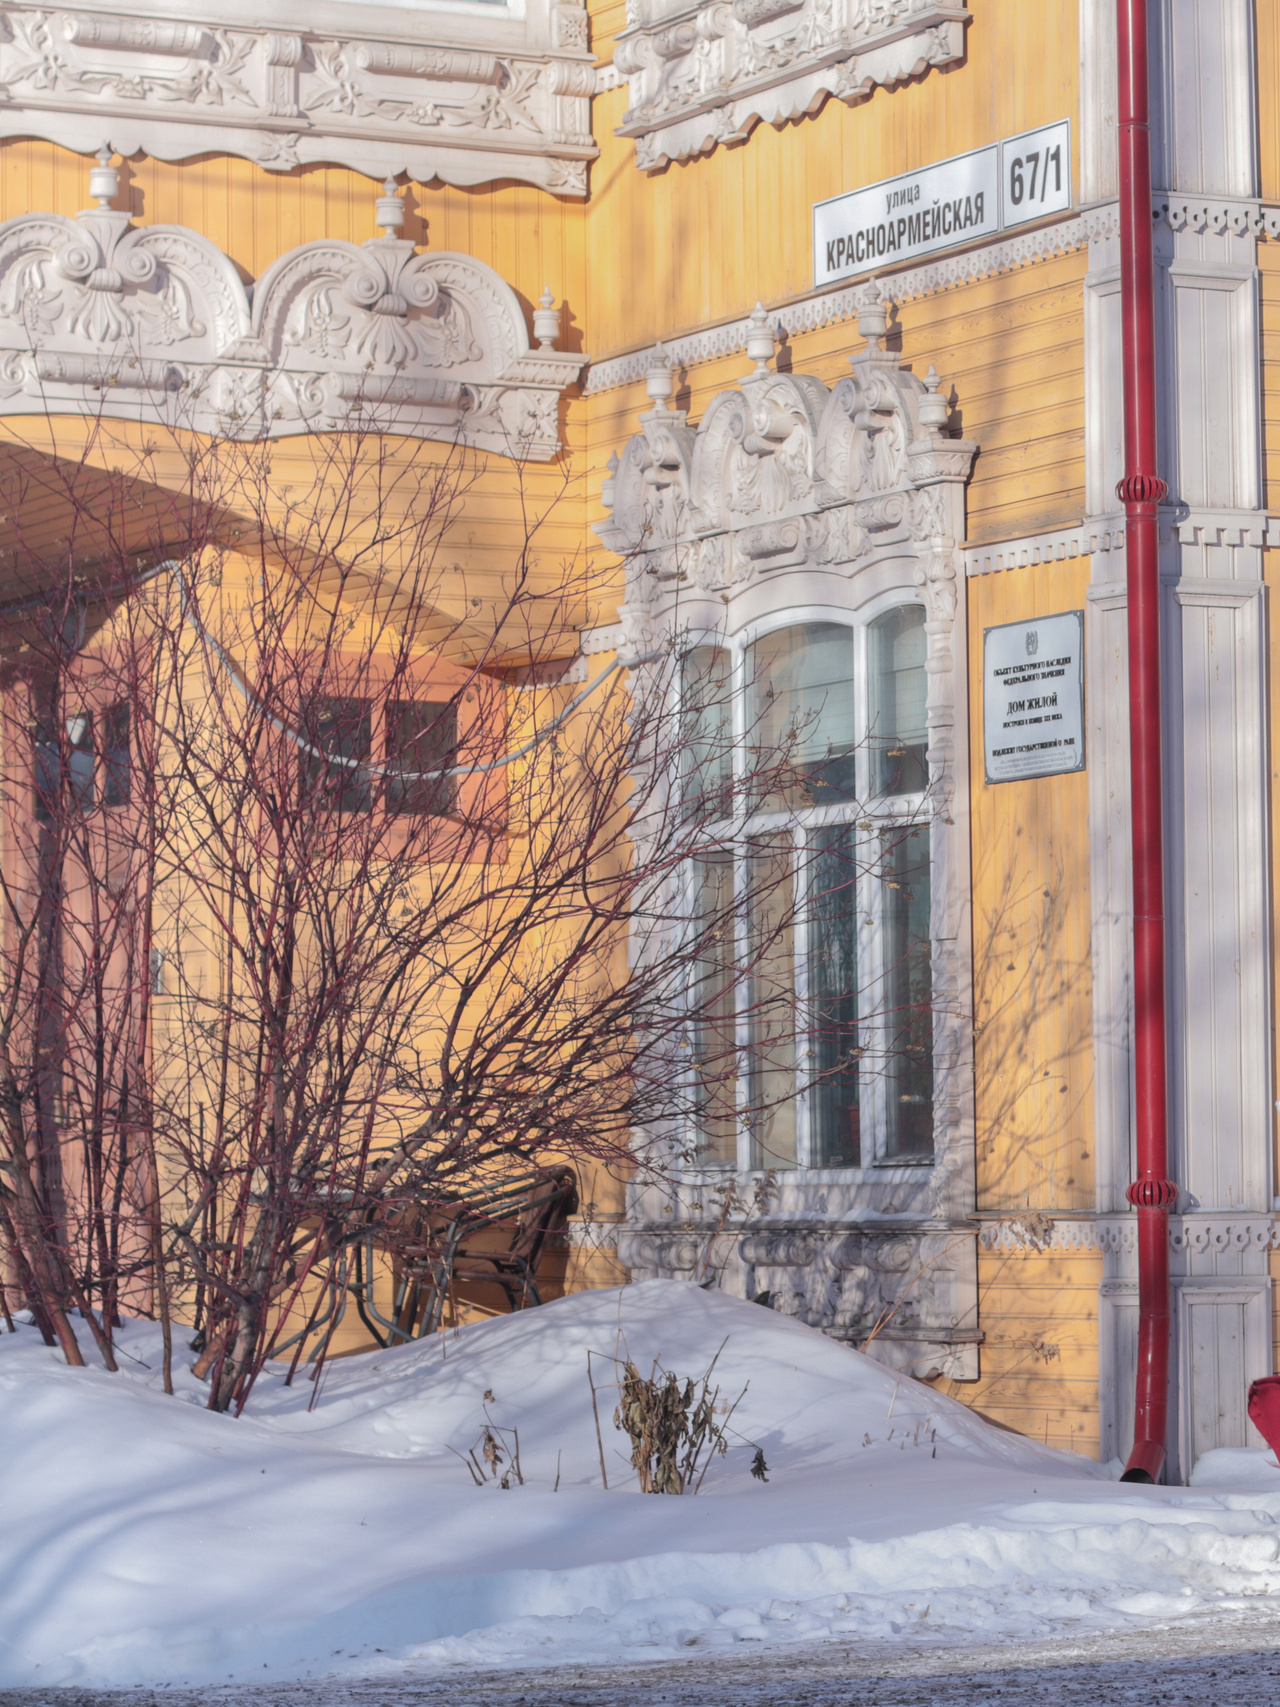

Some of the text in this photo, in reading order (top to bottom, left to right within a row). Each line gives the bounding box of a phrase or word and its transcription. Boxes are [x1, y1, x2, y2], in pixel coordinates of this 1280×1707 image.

[1010, 144, 1061, 206] 67/1
[886, 184, 920, 214] улица
[826, 191, 984, 272] КРАСНОАРМЕЙСКАЯ
[1007, 692, 1058, 716] ДОМ ЖИЛОЙ
